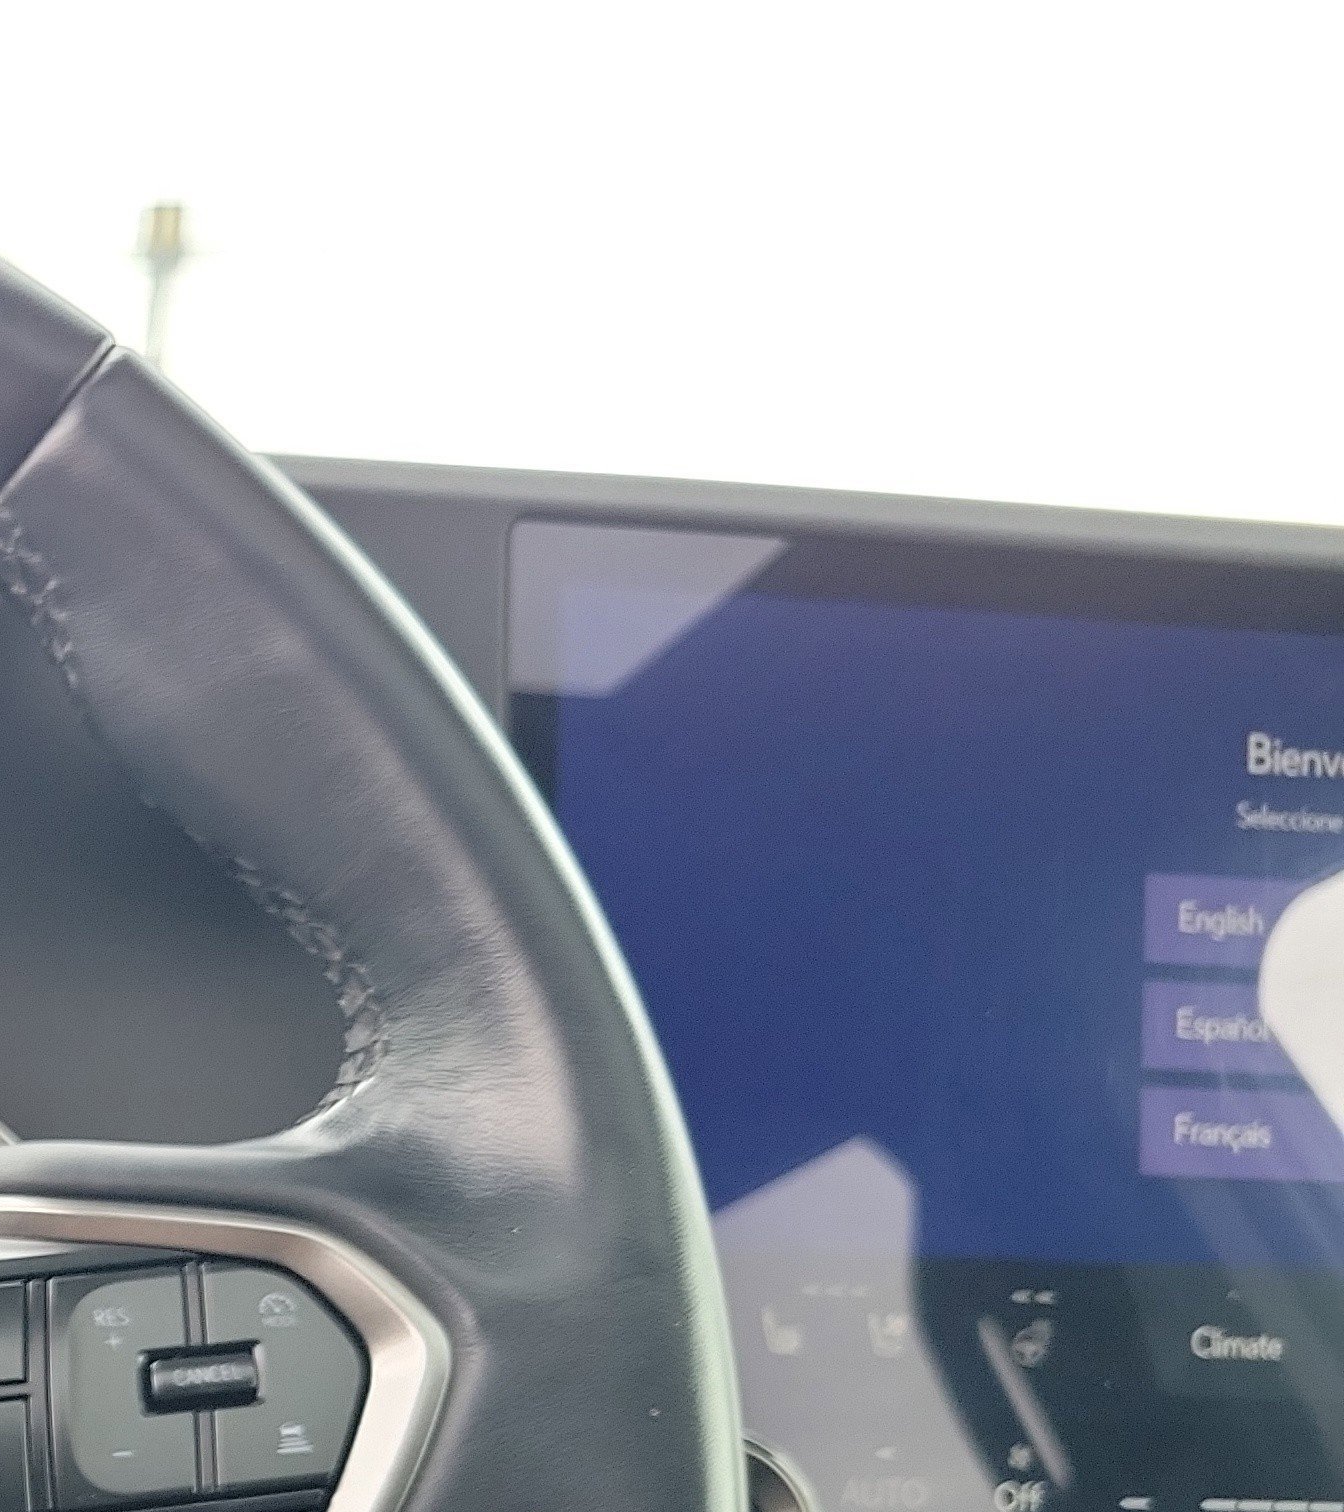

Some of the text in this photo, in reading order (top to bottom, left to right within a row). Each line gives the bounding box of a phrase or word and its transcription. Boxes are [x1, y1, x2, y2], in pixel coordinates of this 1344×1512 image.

[1245, 732, 1344, 777] Bienv
[1235, 801, 1343, 833] Seleccione
[1177, 902, 1264, 938] English
[1172, 1112, 1272, 1152] Français
[93, 1306, 130, 1328] RES
[1190, 1325, 1284, 1361] Climate
